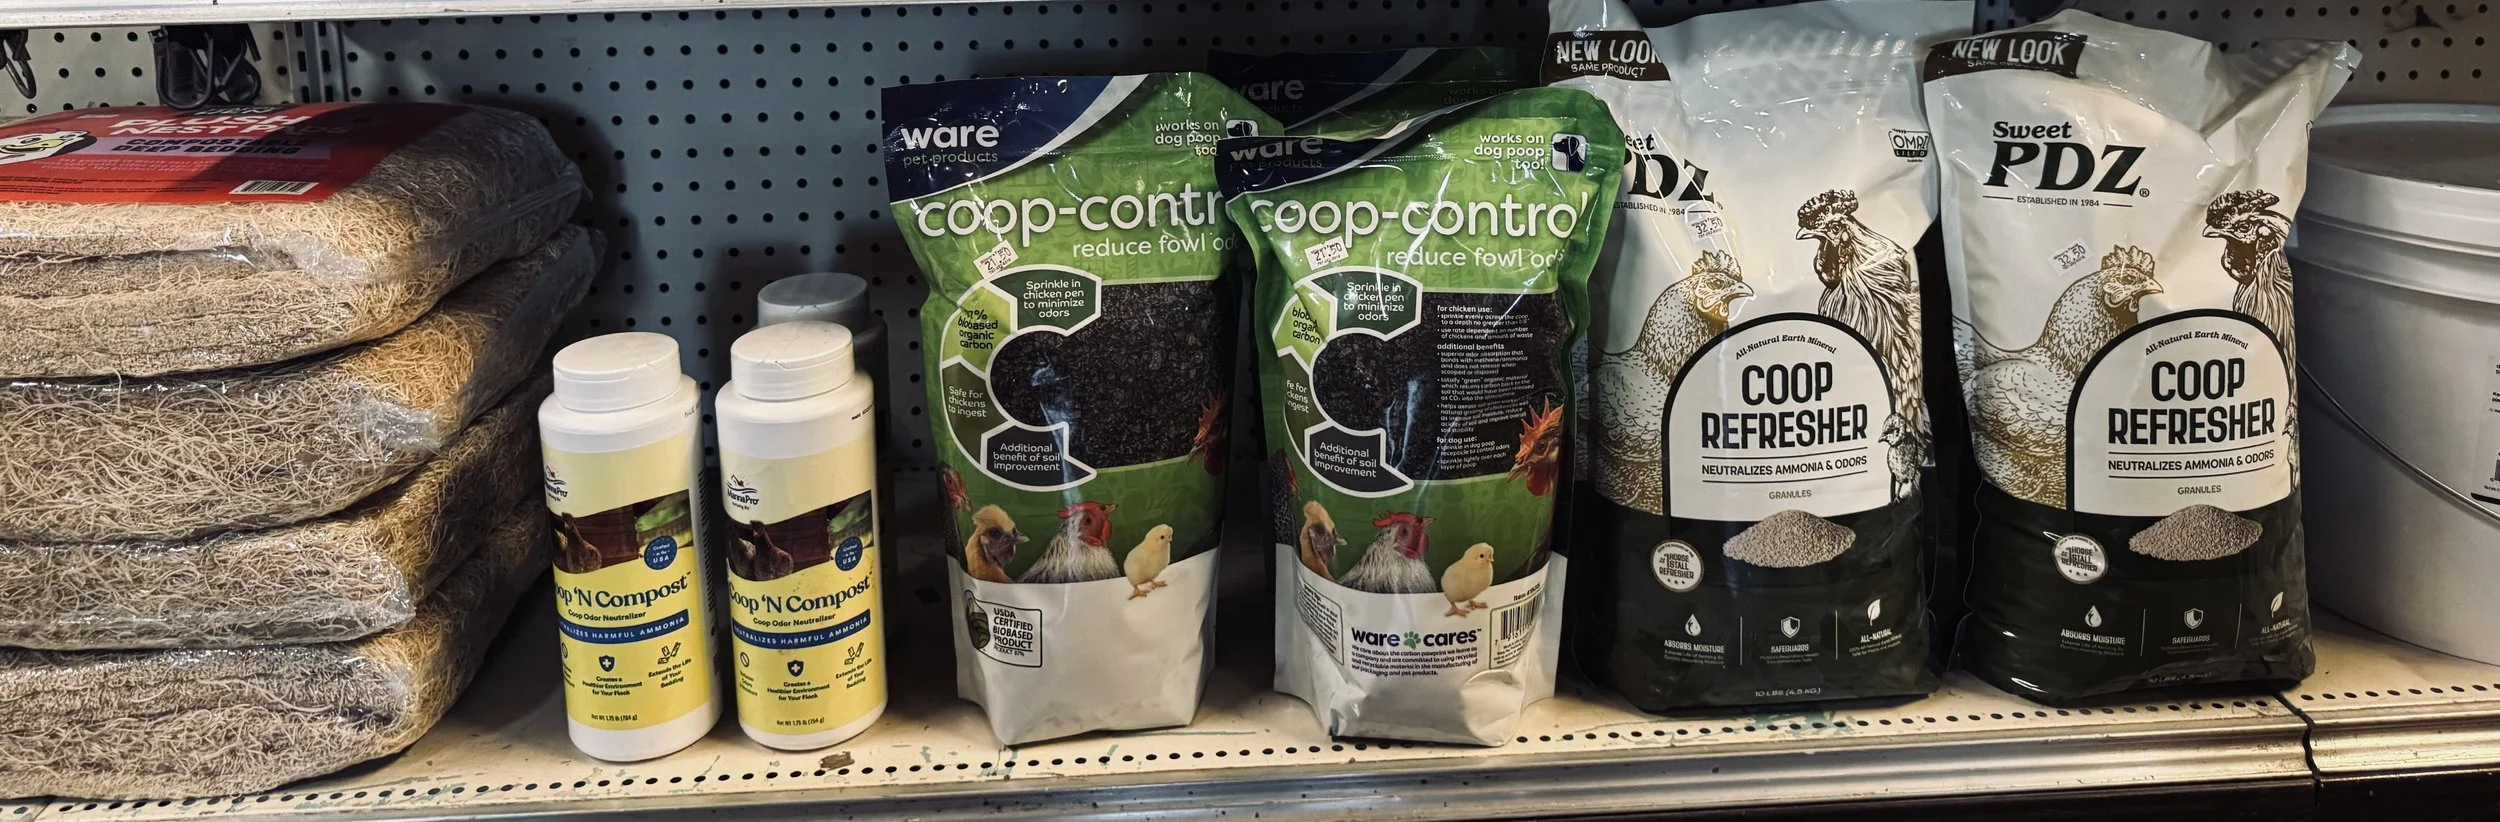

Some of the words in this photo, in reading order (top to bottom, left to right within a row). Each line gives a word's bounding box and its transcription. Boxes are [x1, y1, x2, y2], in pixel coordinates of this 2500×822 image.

[1556, 40, 1602, 64] NEW
[1952, 38, 2002, 61] NEW
[2006, 38, 2070, 66] LOOK
[1571, 62, 1600, 73] SAME
[1602, 63, 1646, 78] PRODUCT
[109, 115, 311, 128] PLUSH
[1156, 119, 1200, 132] works
[1204, 122, 1220, 131] on
[110, 126, 238, 135] NEST
[1992, 120, 2072, 139] Sweet
[126, 138, 308, 146] COMPOSTABLE
[901, 124, 1000, 150] ware
[1155, 133, 1182, 146] dog
[1186, 134, 1220, 146] poop
[1480, 133, 1522, 144] works
[1526, 135, 1544, 144] on
[1893, 135, 1928, 150] OMRI
[183, 146, 302, 155] BEDDING
[1230, 137, 1323, 162] ware
[1474, 144, 1504, 158] dog
[1506, 147, 1544, 158] poop
[903, 154, 931, 167] pet
[932, 151, 998, 164] products
[1515, 158, 1545, 170] too!
[1624, 147, 1715, 202] DZ
[1983, 140, 2146, 196] PDZ
[2016, 196, 2068, 206] ESTABLISHED
[2069, 198, 2078, 206] IN
[2080, 199, 2100, 208] 1984
[918, 183, 1223, 247] coop-contr
[1696, 217, 1724, 235] 32.50
[1073, 238, 1151, 258] reduce
[1158, 234, 1206, 253] fowl
[1314, 242, 1342, 262] 21.50
[1387, 248, 1470, 267] reduce
[1474, 246, 1522, 267] fowl
[1026, 280, 1068, 291] Sprinkle
[1072, 279, 1080, 288] in
[1392, 283, 1402, 292] in
[1024, 288, 1062, 300] chicken
[1065, 290, 1084, 299] pen
[1385, 294, 1404, 303] pen
[1024, 300, 1035, 309] to
[1038, 300, 1084, 309] minimize
[1344, 302, 1354, 310] to
[1358, 302, 1404, 312] minimize
[1038, 308, 1070, 318] odors
[1358, 312, 1390, 321] odors
[958, 316, 998, 330] biobased
[959, 330, 994, 341] organic
[1292, 330, 1320, 345] carbon
[960, 338, 993, 350] carbon
[1736, 334, 1780, 360] All-Natural
[1782, 334, 1806, 343] Earth
[1807, 336, 1837, 354] Mineral
[2145, 331, 2192, 356] All-Natural
[2194, 331, 2220, 340] Earth
[2221, 333, 2249, 350] Mineral
[1742, 362, 1833, 406] COOP
[2151, 358, 2245, 402] COOP
[950, 386, 967, 398] Safe
[969, 387, 984, 398] for
[949, 396, 986, 408] chickens
[948, 405, 957, 414] to
[958, 406, 987, 418] ingest
[1702, 404, 1868, 450] REFRESHER
[2108, 398, 2276, 444] REFRESHER
[1000, 442, 1052, 452] Additional
[1320, 442, 1370, 458] Additional
[993, 452, 1027, 462] benefit
[1030, 452, 1042, 462] of
[1043, 452, 1060, 461] soil
[1314, 448, 1344, 464] benefit
[1347, 456, 1357, 464] of
[1359, 459, 1376, 468] soil
[2108, 460, 2182, 471] NEUTRALIZES
[2184, 458, 2234, 470] AMMONIA
[2236, 456, 2244, 466] &
[2244, 450, 2274, 464] ODORS
[994, 462, 1060, 472] improvement
[1315, 458, 1377, 478] improvement
[1702, 464, 1773, 476] NEUTRALIZES
[1775, 462, 1824, 475] AMMONIA
[1826, 462, 1834, 470] &
[1834, 456, 1868, 470] ODORS
[1768, 490, 1812, 500] GRANULES
[2178, 485, 2222, 495] GRANULES
[653, 556, 670, 564] USA
[596, 575, 688, 608] Compost
[786, 576, 870, 613] Compost
[568, 609, 583, 620] Coop
[584, 613, 602, 621] Odor
[602, 612, 647, 621] Neutralizer
[753, 618, 770, 627] Coop
[794, 614, 836, 626] Neutralizer
[994, 608, 1016, 619] USDA
[640, 616, 684, 636] AMMONIA
[780, 634, 824, 644] HARMFUL
[828, 616, 868, 638] AMMONIA
[994, 616, 1034, 631] CERTIFIED
[993, 626, 1034, 640] BIOBASED
[1352, 627, 1400, 647] ware
[1423, 629, 1478, 647] cares
[2060, 628, 2091, 642] ABSORBS
[2092, 635, 2126, 645] MOISTURE
[994, 634, 1032, 650] PRODUCT
[1664, 639, 1692, 650] ABSORBS
[1693, 644, 1725, 653] MOISTURE
[604, 681, 642, 690] Environment
[792, 684, 830, 694] Environment
